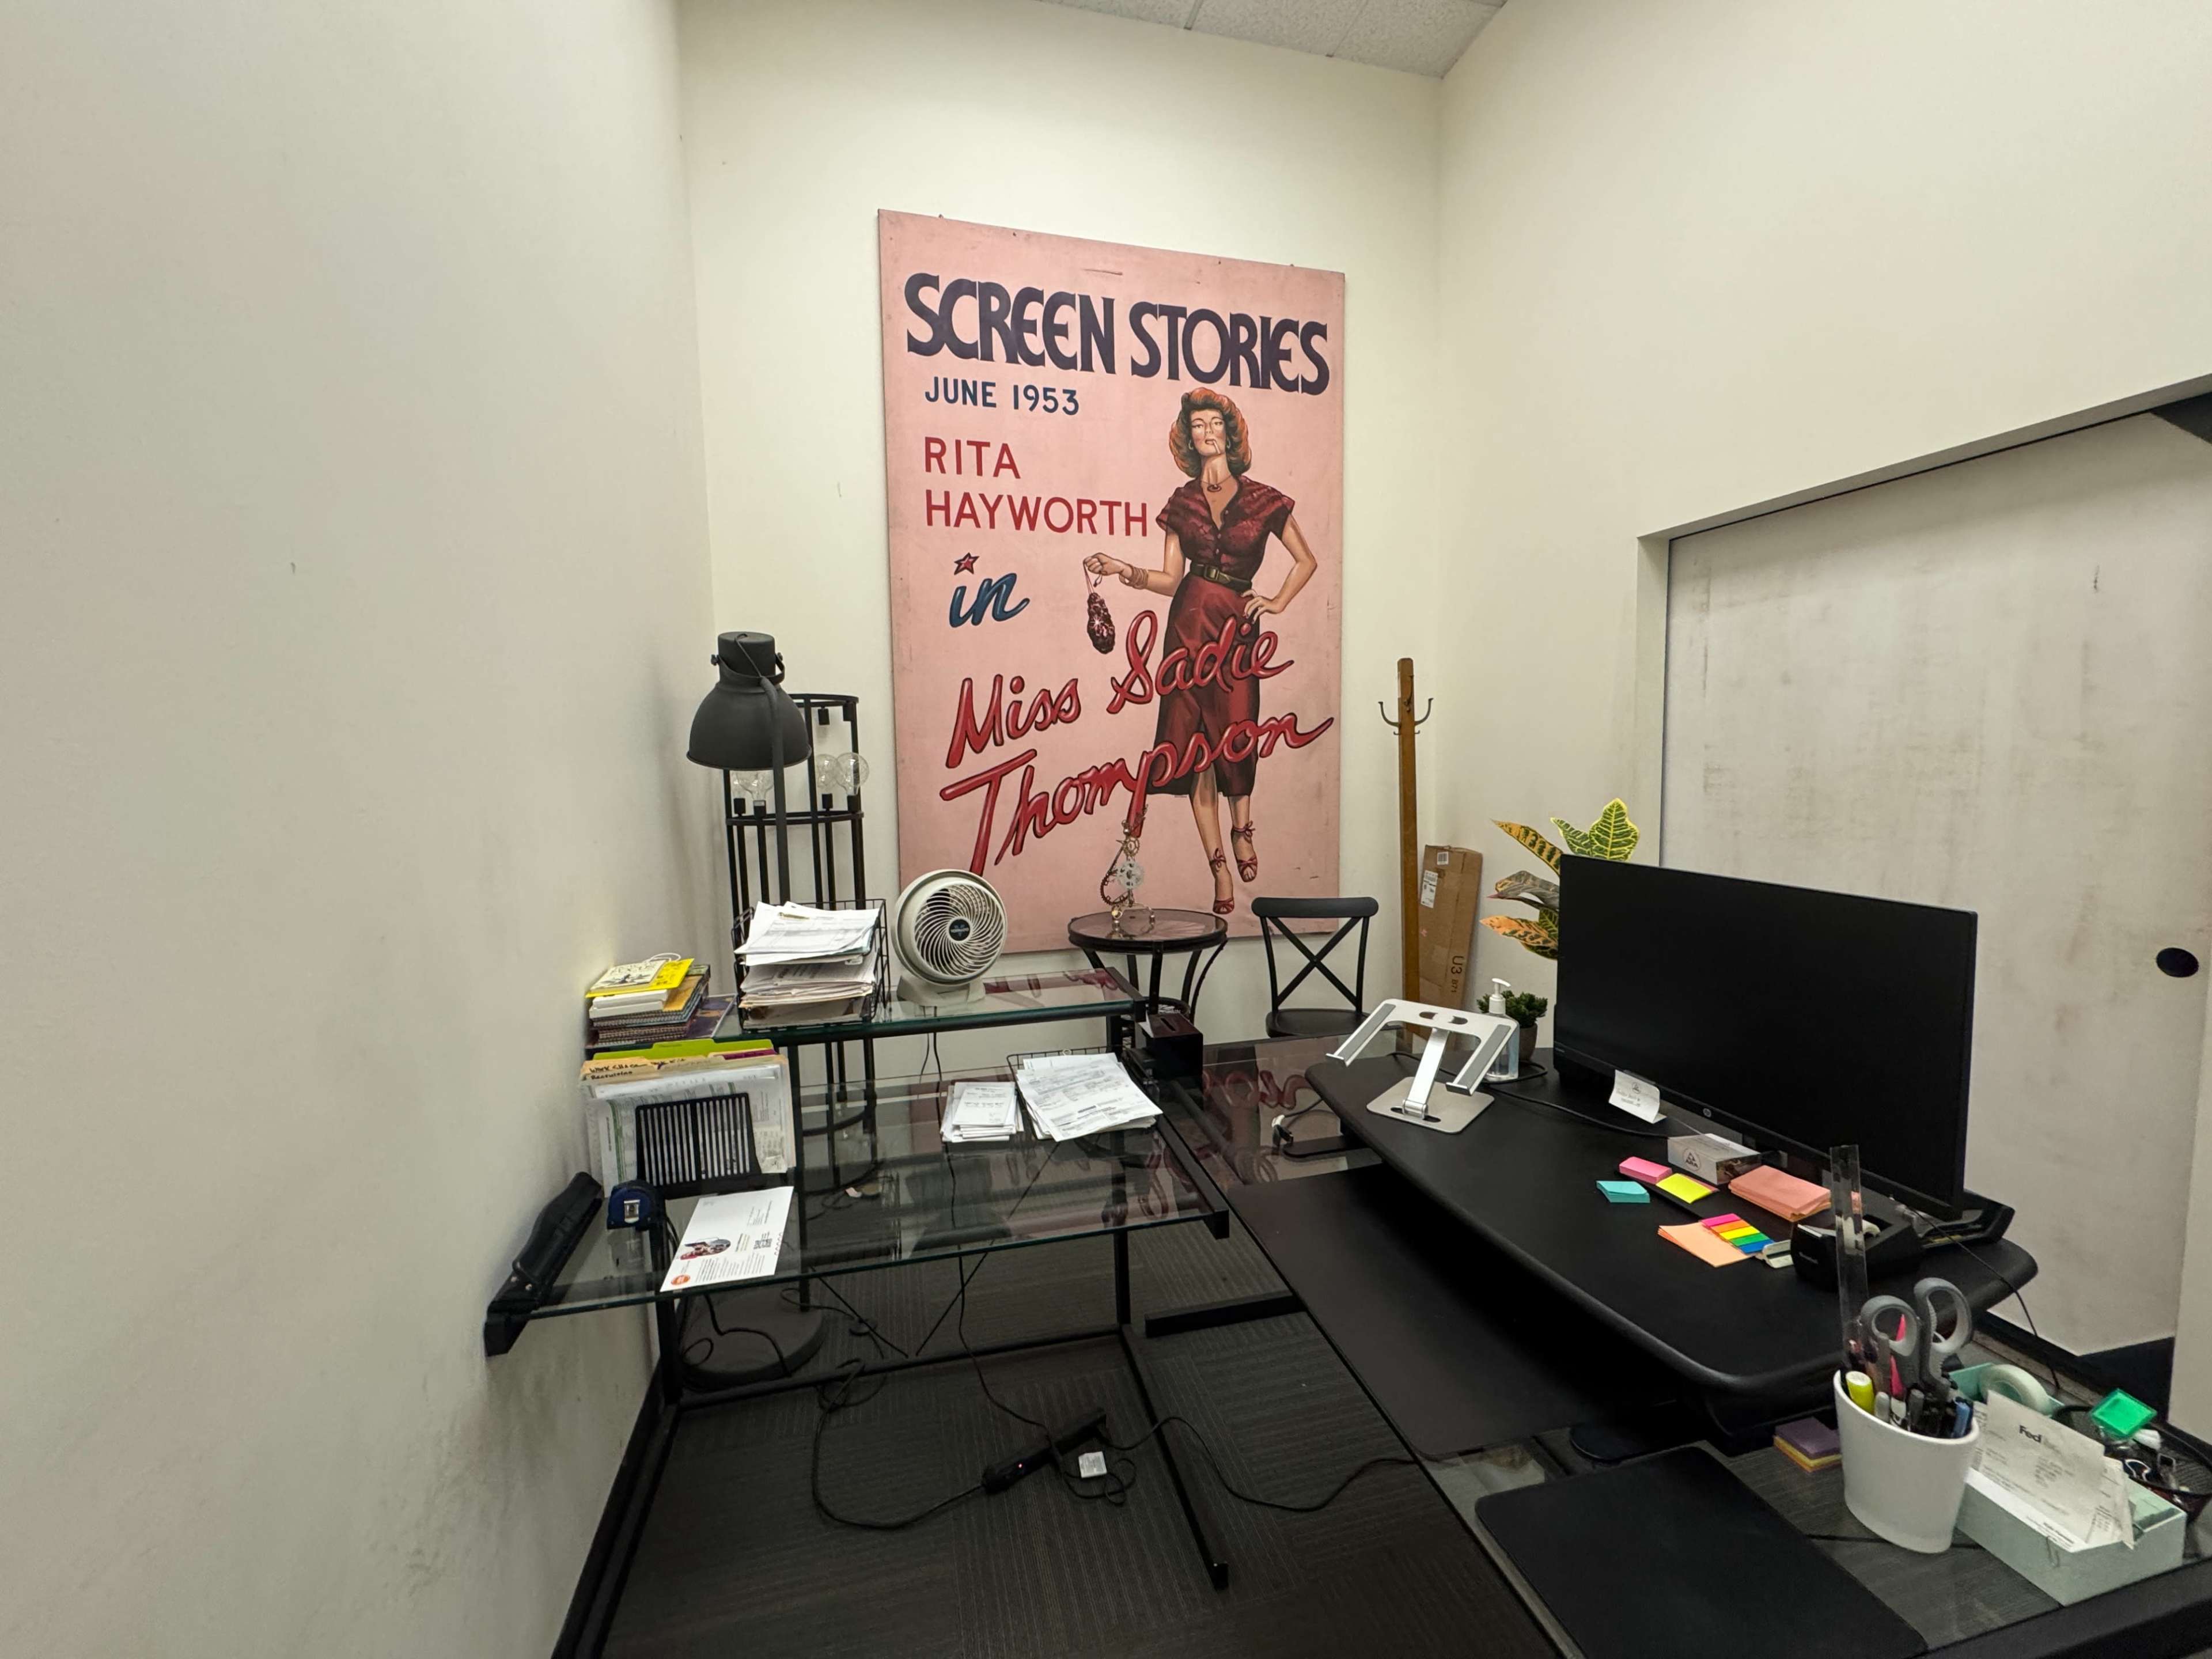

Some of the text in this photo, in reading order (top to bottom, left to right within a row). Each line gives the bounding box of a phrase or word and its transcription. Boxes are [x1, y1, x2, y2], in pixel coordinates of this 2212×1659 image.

[904, 273, 1330, 396] SCREEN STORIES
[925, 376, 1080, 415] JUNE 1953
[924, 436, 1021, 480] RITA
[925, 490, 1147, 537] HAYWORTH
[949, 552, 1030, 628] in
[945, 609, 1294, 768] Miss Sadie
[939, 712, 1334, 877] Thompson
[1450, 955, 1464, 975] U3
